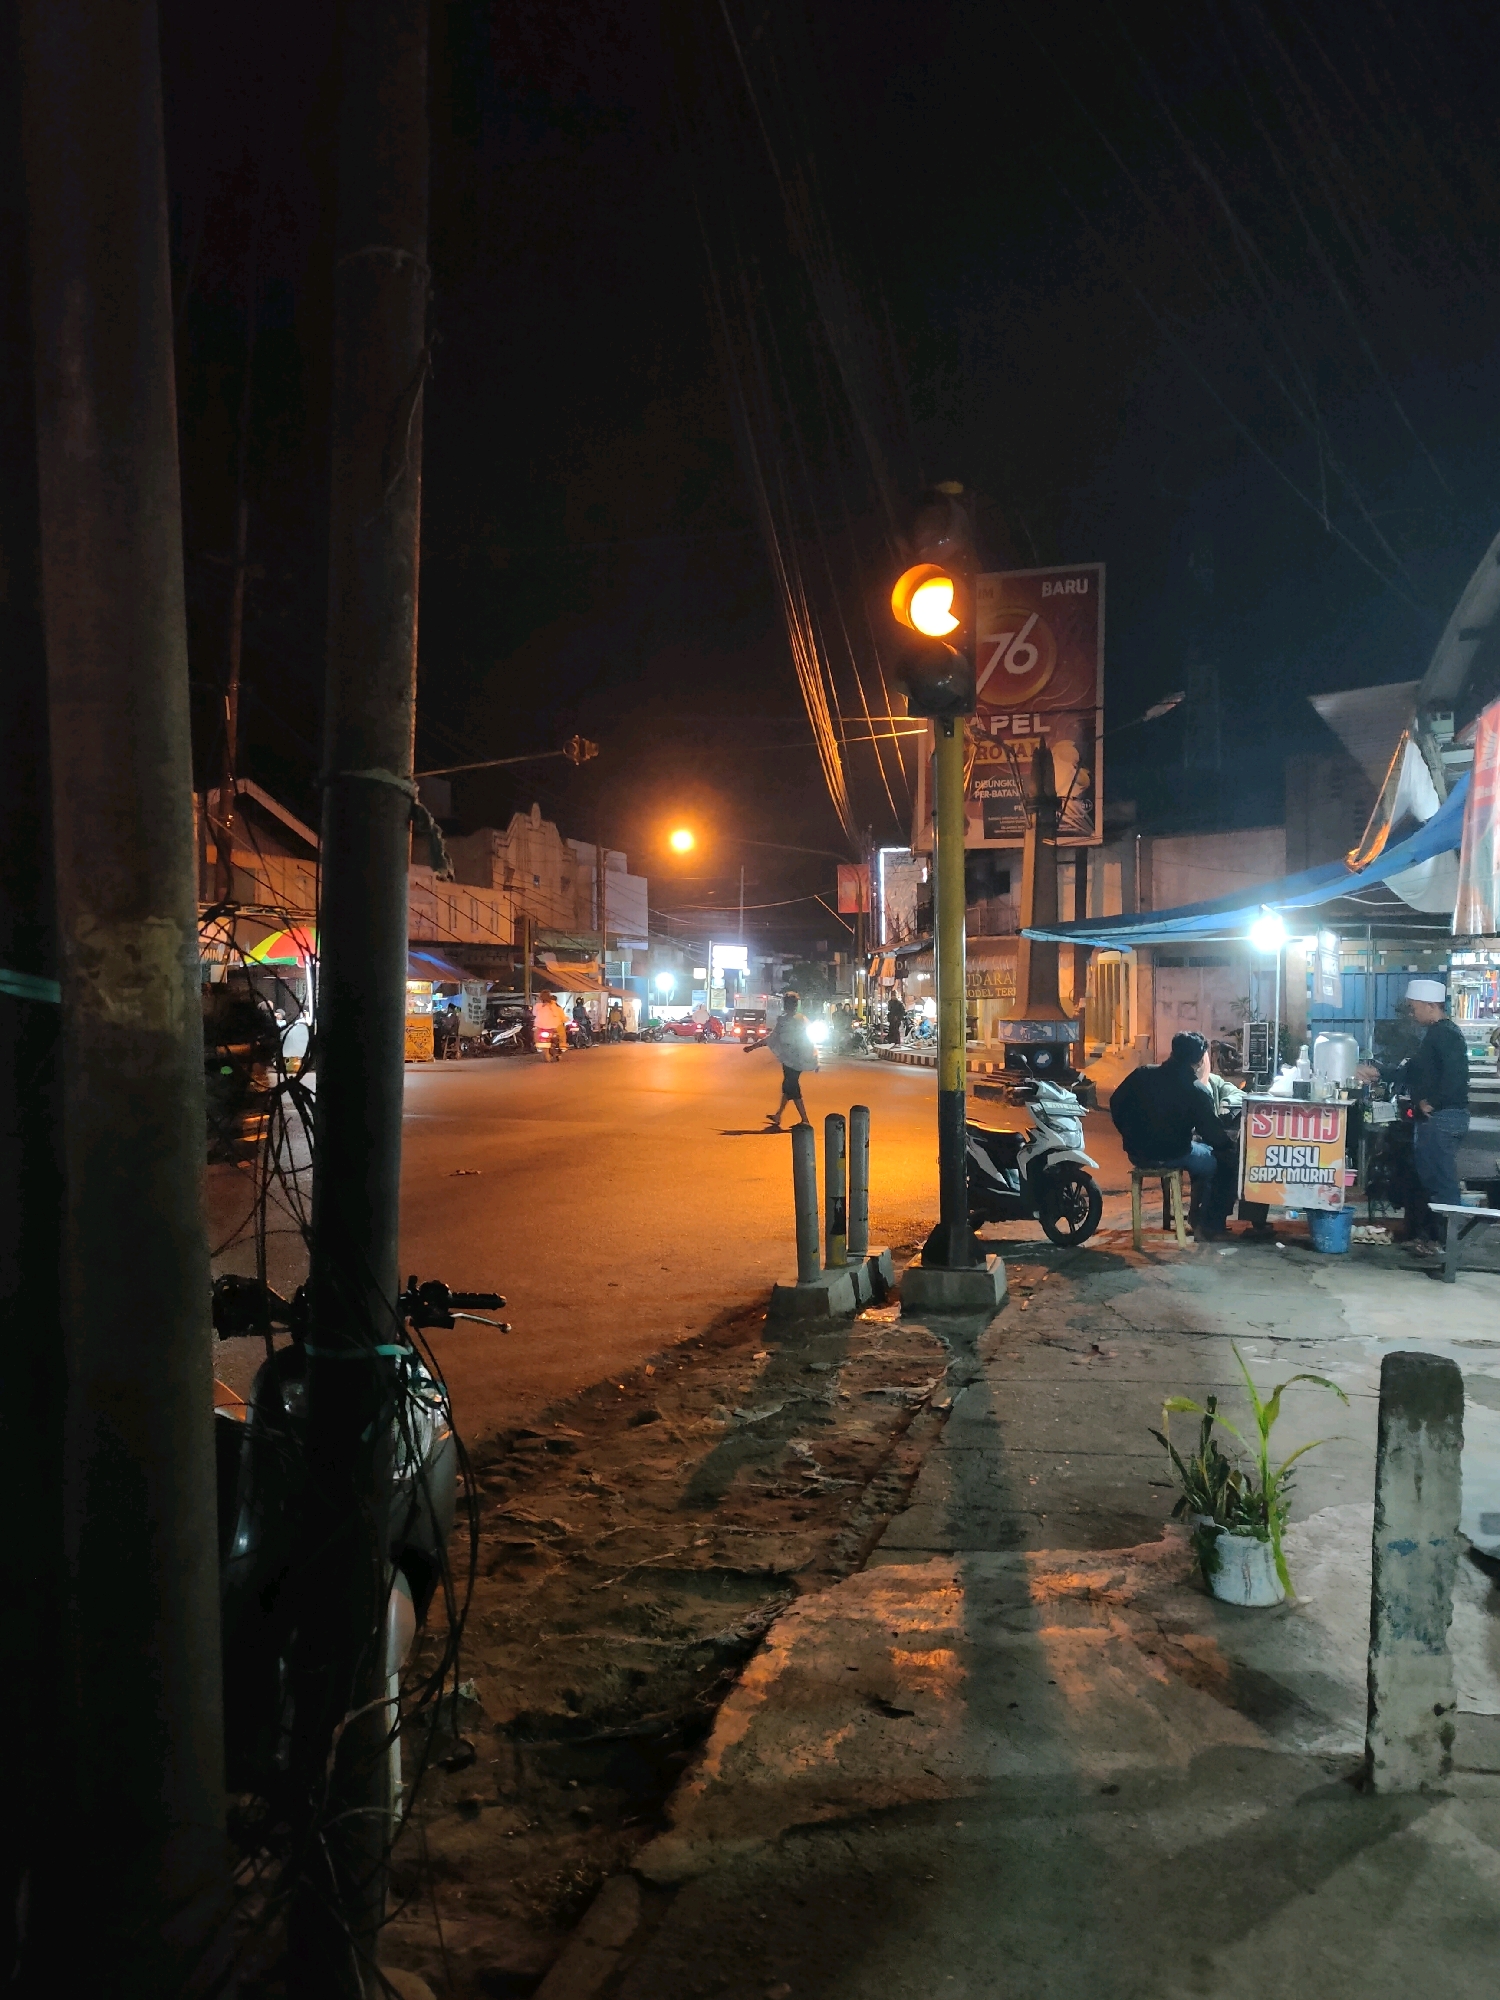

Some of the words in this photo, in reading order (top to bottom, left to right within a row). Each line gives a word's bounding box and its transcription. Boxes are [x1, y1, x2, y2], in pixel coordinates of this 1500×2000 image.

[1041, 578, 1089, 598] BARU
[976, 612, 1039, 695] 76
[969, 713, 1051, 736] APEL
[1250, 1103, 1341, 1144] STMJ
[1265, 1145, 1320, 1168] SUSU
[1249, 1166, 1283, 1184] SAPI
[1287, 1167, 1336, 1185] MURNI
